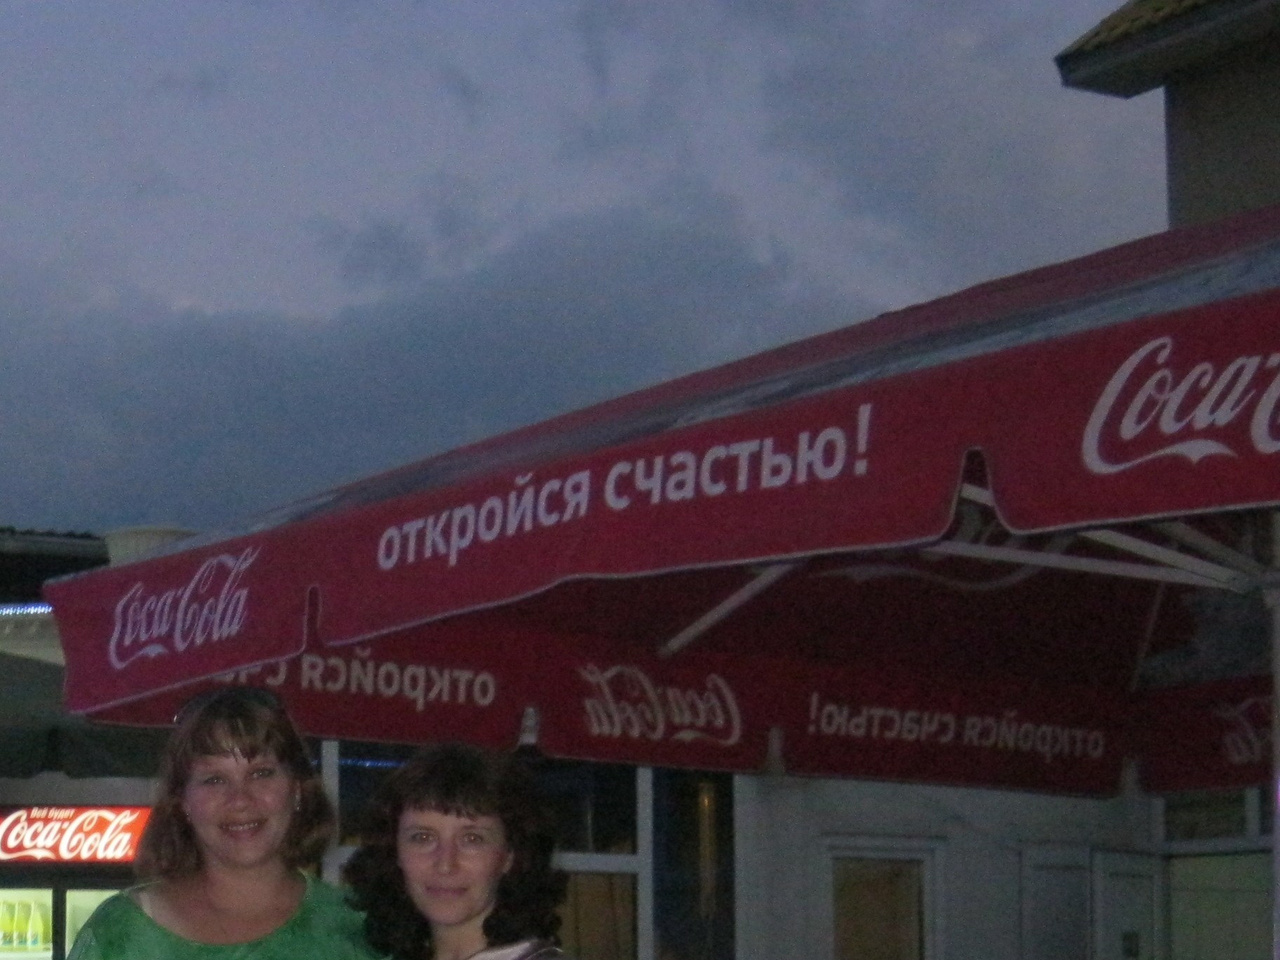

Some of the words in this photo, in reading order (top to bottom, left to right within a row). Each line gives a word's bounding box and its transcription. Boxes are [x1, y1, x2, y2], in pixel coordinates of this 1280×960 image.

[376, 473, 592, 571] откройся
[603, 403, 873, 510] счастью!
[108, 545, 263, 670] Coca-Cola
